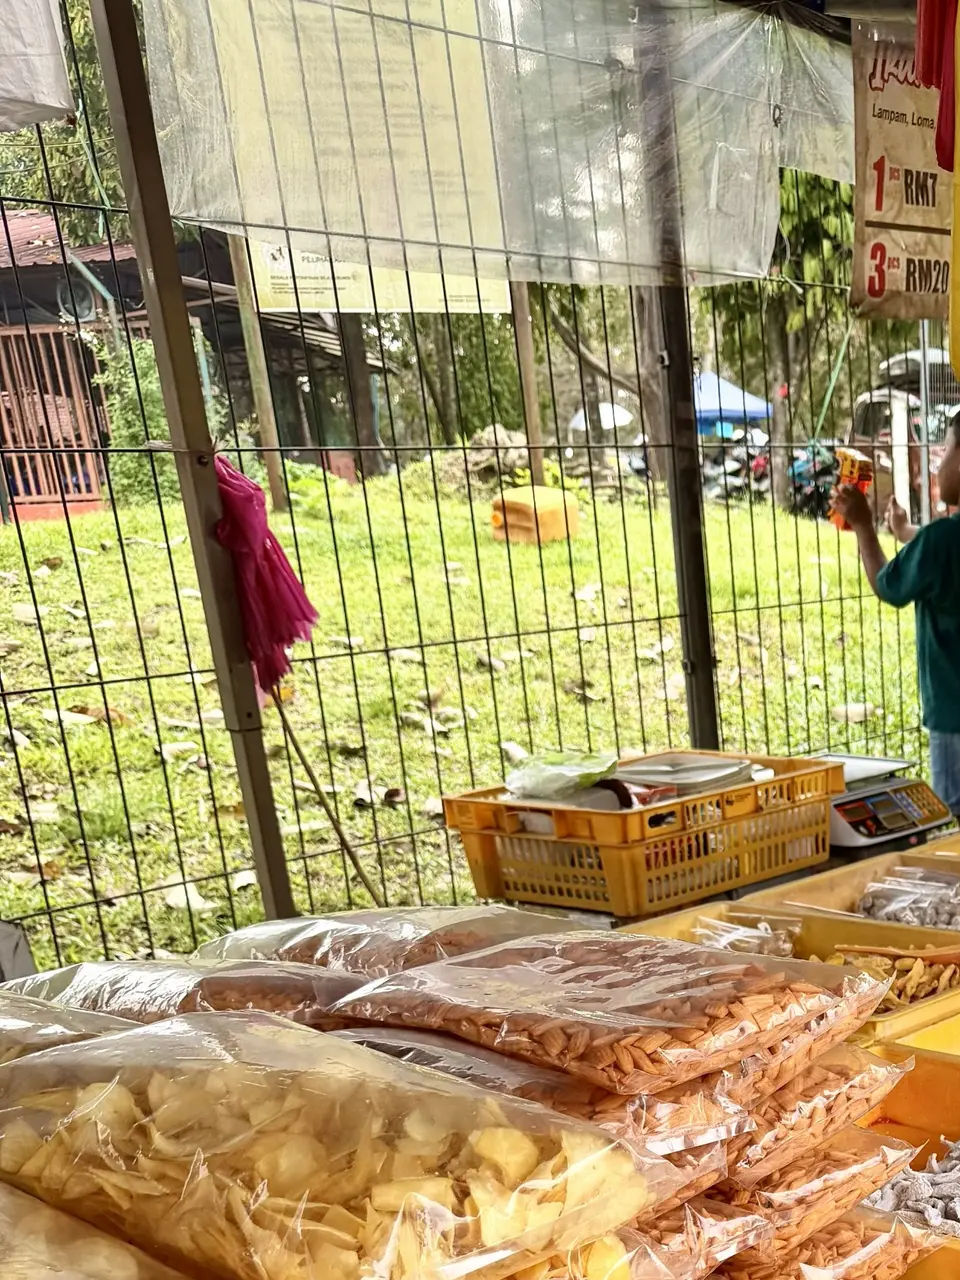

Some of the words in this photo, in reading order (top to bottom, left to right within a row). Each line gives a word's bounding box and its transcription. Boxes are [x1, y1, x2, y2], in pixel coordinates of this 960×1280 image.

[872, 103, 909, 127] Lampam,
[873, 155, 885, 211] 1
[904, 168, 938, 207] RM7
[867, 242, 886, 298] 3
[905, 257, 950, 294] RM20
